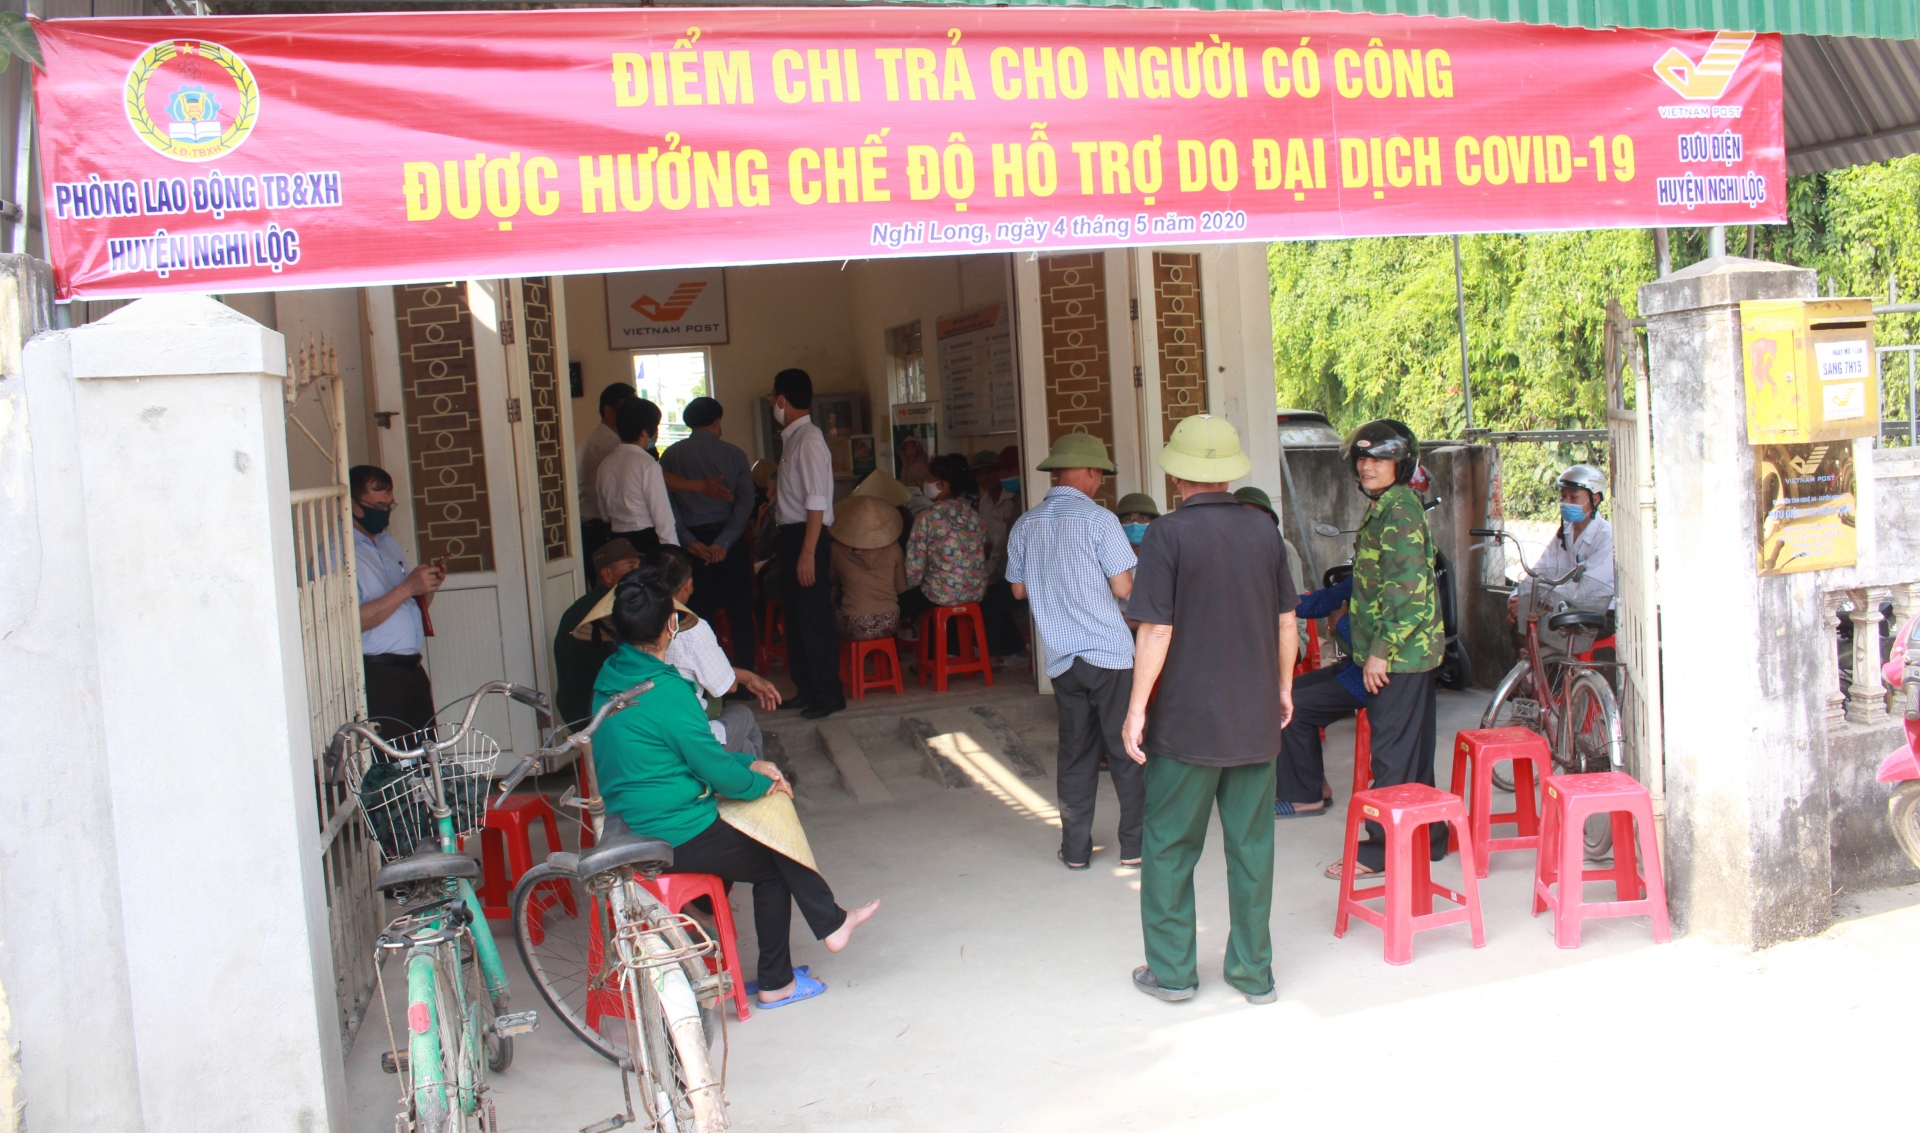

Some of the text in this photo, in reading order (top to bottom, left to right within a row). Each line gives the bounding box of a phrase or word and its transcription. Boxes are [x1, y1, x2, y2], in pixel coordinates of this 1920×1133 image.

[611, 26, 1454, 108] ĐIỂM CHI TRẢ CHO NGƯỜI CÓ CÔNG
[1658, 107, 1742, 118] VIETNAM POST
[172, 146, 222, 158] LĐ-TBXH
[1679, 130, 1741, 165] BƯU ĐIỆN
[402, 122, 1636, 231] ĐƯỢC HƯỞNG CHẾ ĐỘ HỖ TRỢ DO ĐẠI DỊCH COVID-19
[1658, 172, 1765, 208] HUYỆN NGHI LỘC
[55, 171, 340, 218] PHÒNG LAO ĐỘNG TB&XH
[872, 212, 1246, 247] Nghi Long, ngày 4 tháng 5 năm 2020
[109, 224, 299, 276] HUYỆN NGHI LỘC
[622, 323, 720, 336] VIETNAM POST
[1844, 360, 1862, 374] 7H15
[907, 407, 934, 416] CREDIT
[1784, 477, 1816, 485] VIETNAM
